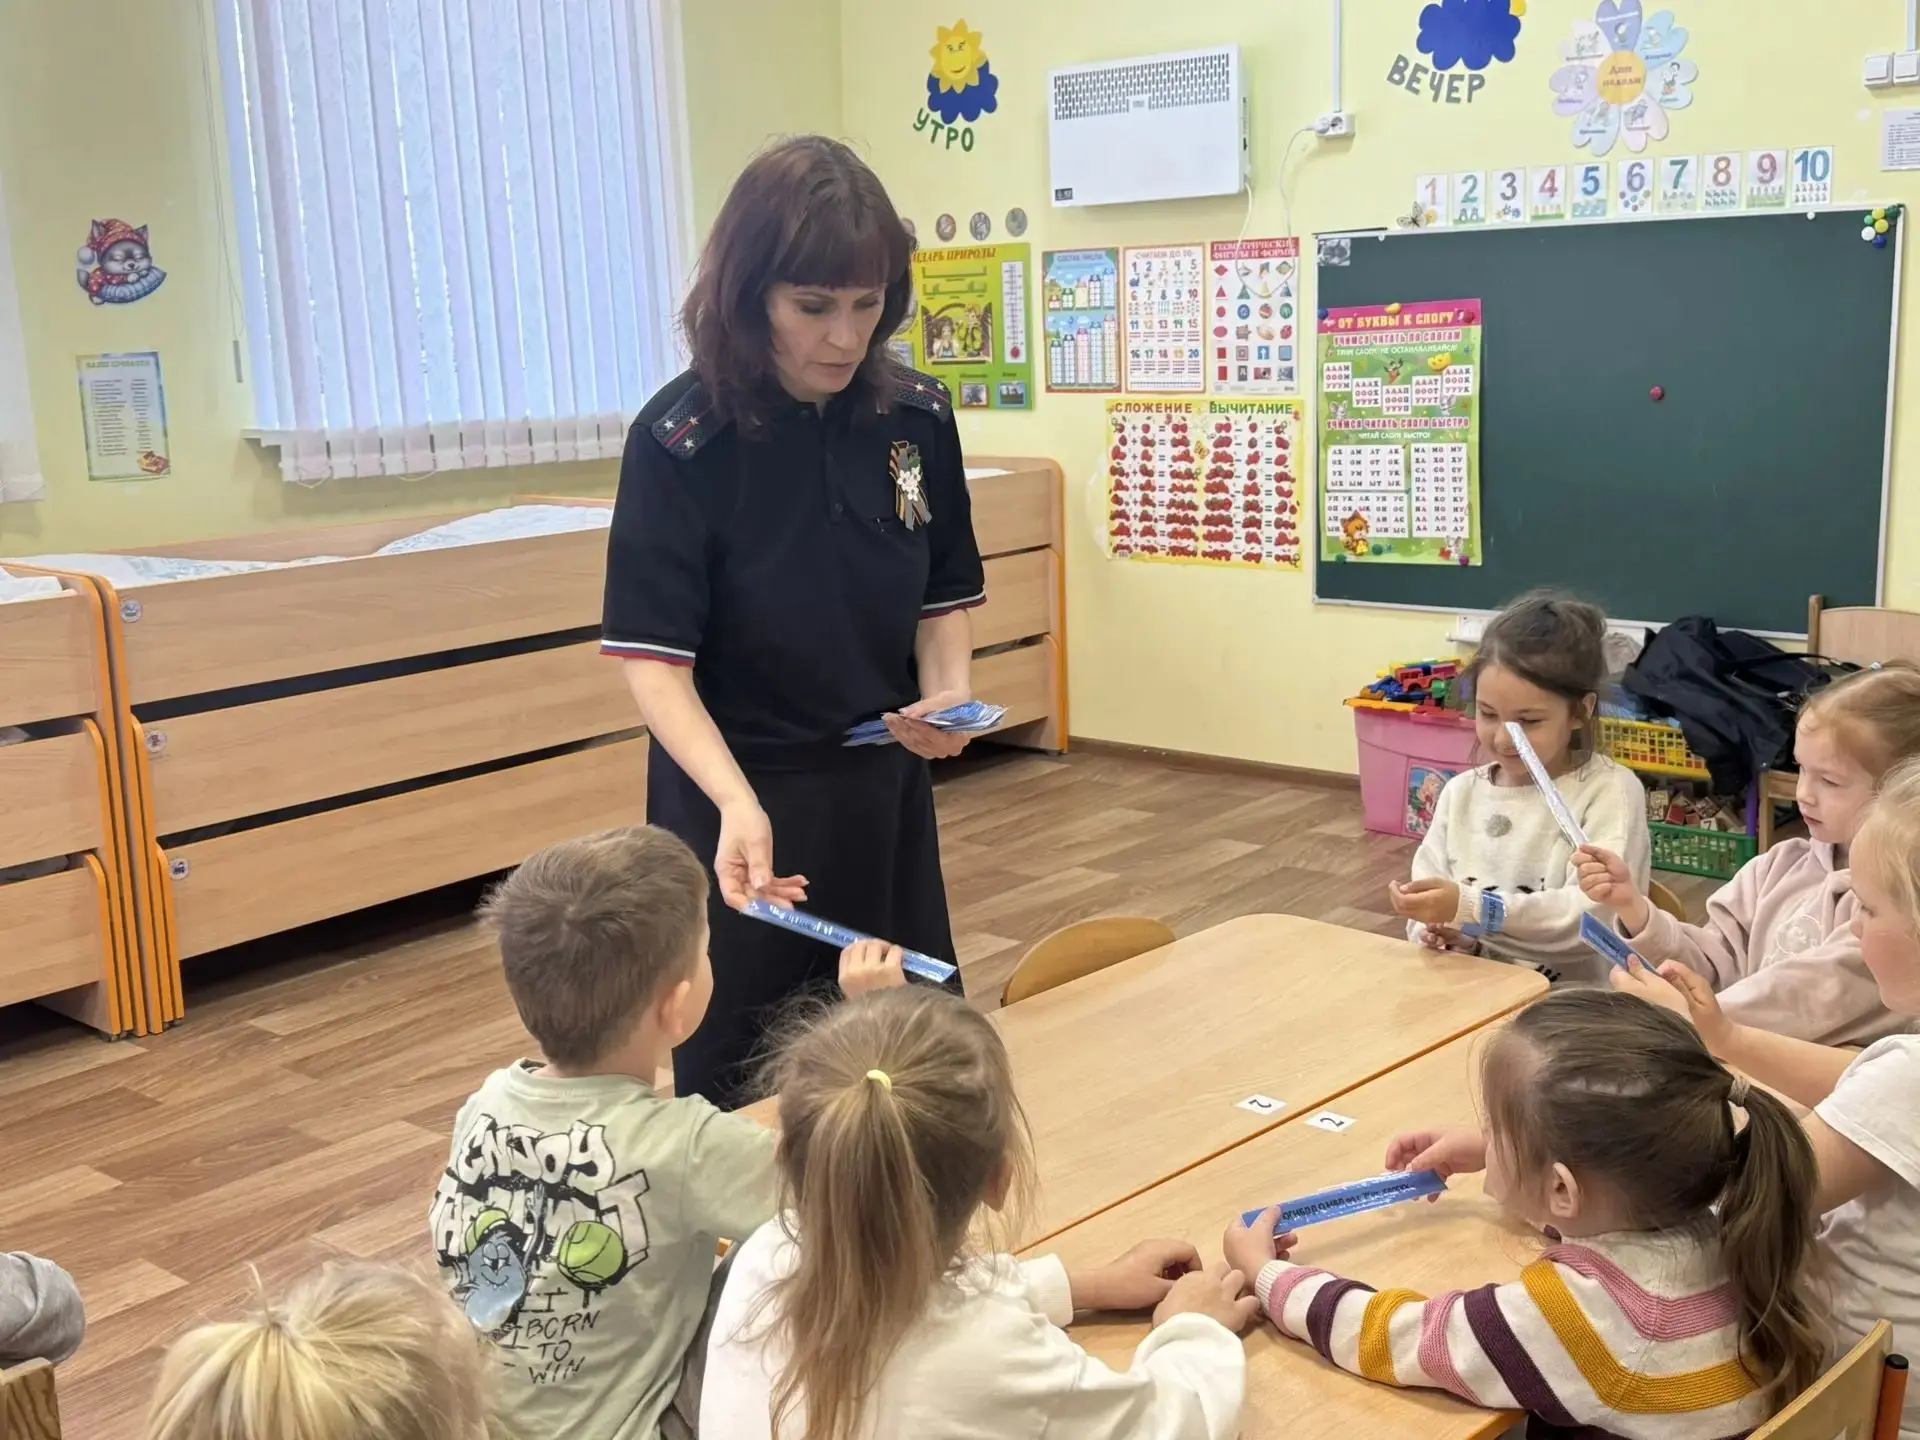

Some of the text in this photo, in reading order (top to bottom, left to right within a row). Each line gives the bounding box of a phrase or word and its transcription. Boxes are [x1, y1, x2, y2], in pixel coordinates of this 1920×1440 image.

[1387, 53, 1486, 104] ВЕЧЕР
[913, 107, 974, 152] УТРО
[1425, 149, 1830, 205] 1 2 3 4 5 6 7 8 9 10
[1130, 318, 1198, 330] 11 12 13 14 15
[1338, 311, 1454, 329] ОТ БУКВЫ К СЛОГУ
[1371, 332, 1406, 345] ЧИТАТЬ
[1408, 331, 1421, 343] ПО
[1423, 330, 1461, 343] СЛОГАМ
[1115, 401, 1292, 415] СЛОЖЕНИЕ ВЫЧИТАНИЕ
[1364, 418, 1398, 429] ЧИТАТЬ
[1400, 417, 1429, 428] СЛОГИ
[1431, 416, 1470, 428] БЫСТРО
[1248, 1099, 1272, 1108] 2
[1319, 1117, 1345, 1128] 2
[537, 1339, 572, 1361] TO
[528, 1356, 586, 1384] WIN
